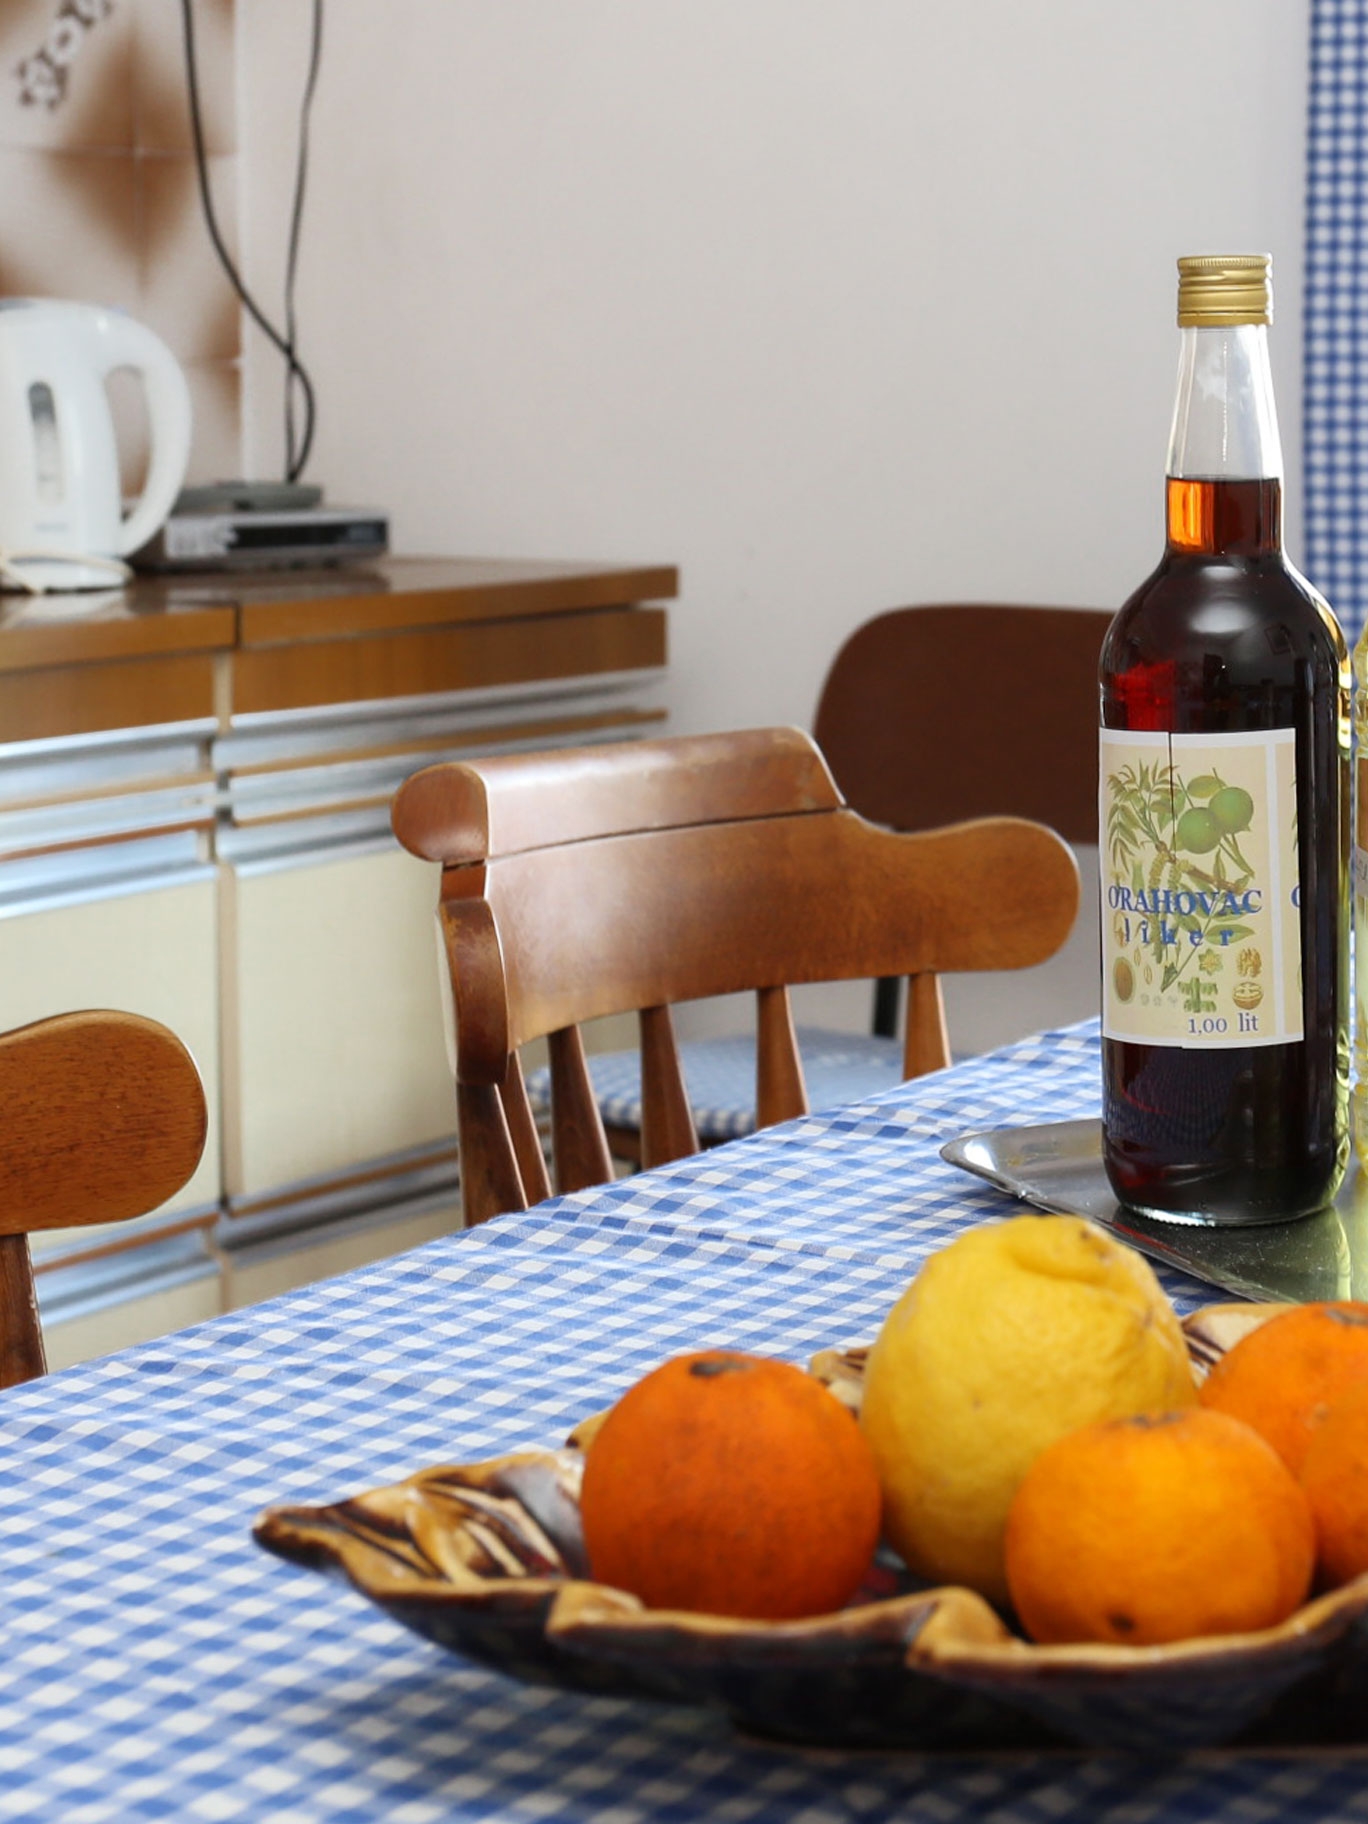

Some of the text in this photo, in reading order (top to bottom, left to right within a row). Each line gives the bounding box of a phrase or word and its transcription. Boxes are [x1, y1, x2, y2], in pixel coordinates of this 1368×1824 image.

[1108, 884, 1263, 916] ORAHOVAC
[1124, 918, 1234, 946] liker
[1188, 1011, 1259, 1036] 1,00 lit
